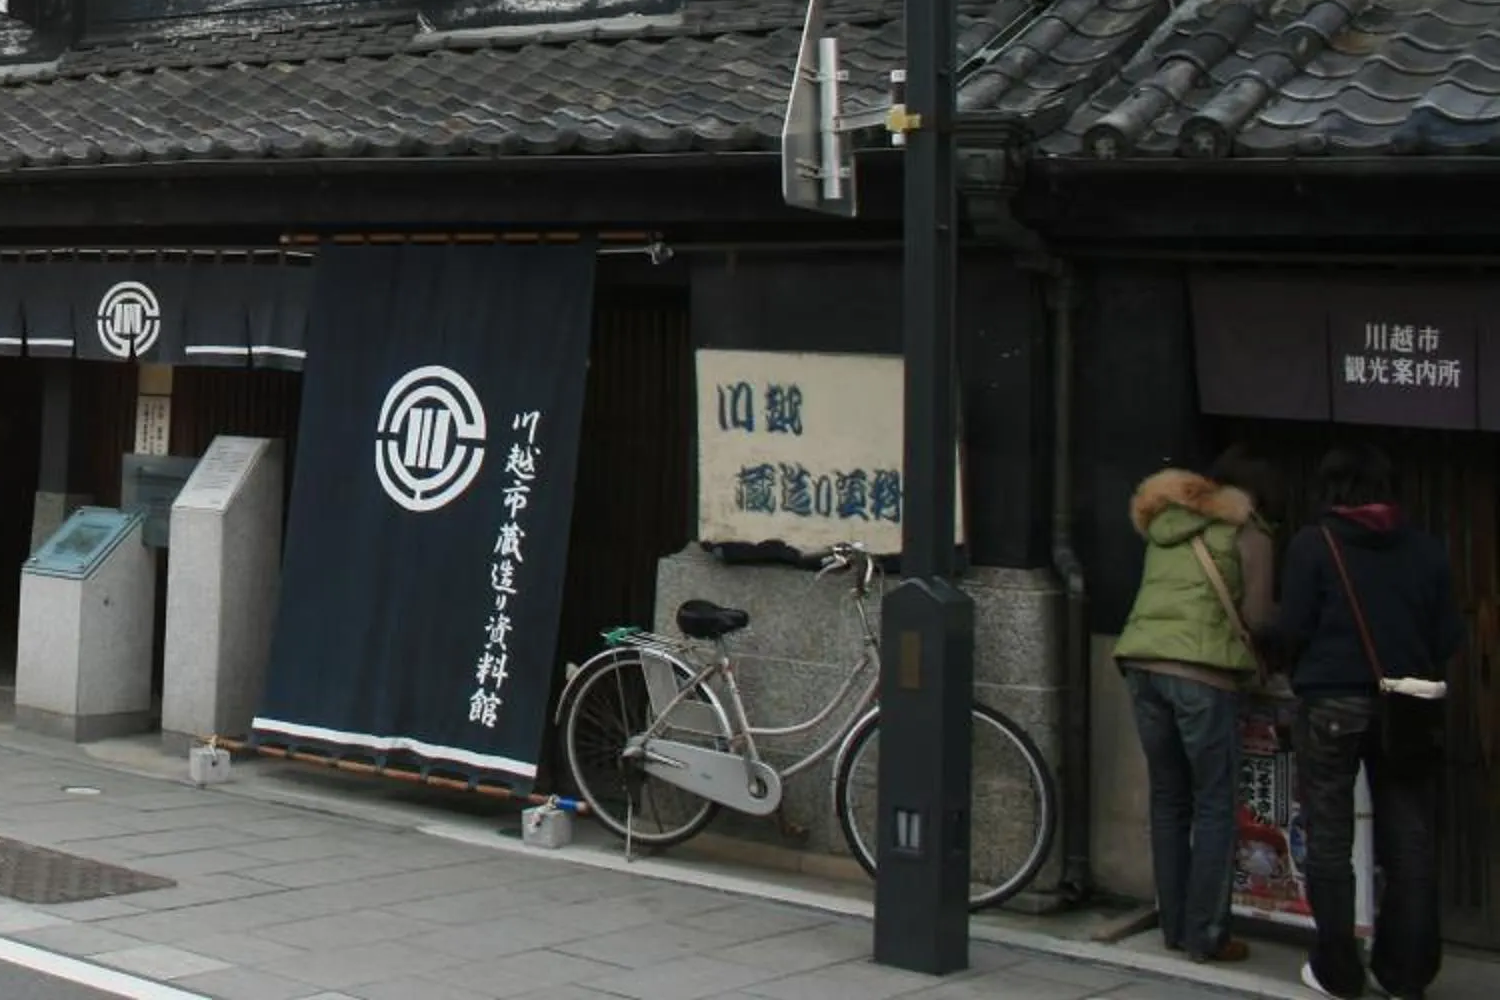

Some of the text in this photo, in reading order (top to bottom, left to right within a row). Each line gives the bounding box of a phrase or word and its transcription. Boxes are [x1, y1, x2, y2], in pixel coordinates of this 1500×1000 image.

[1364, 322, 1442, 354] 川越市
[1344, 354, 1461, 389] 観光案内所
[716, 381, 804, 437] 川越
[469, 409, 541, 729] 川越市蔵造り資料館
